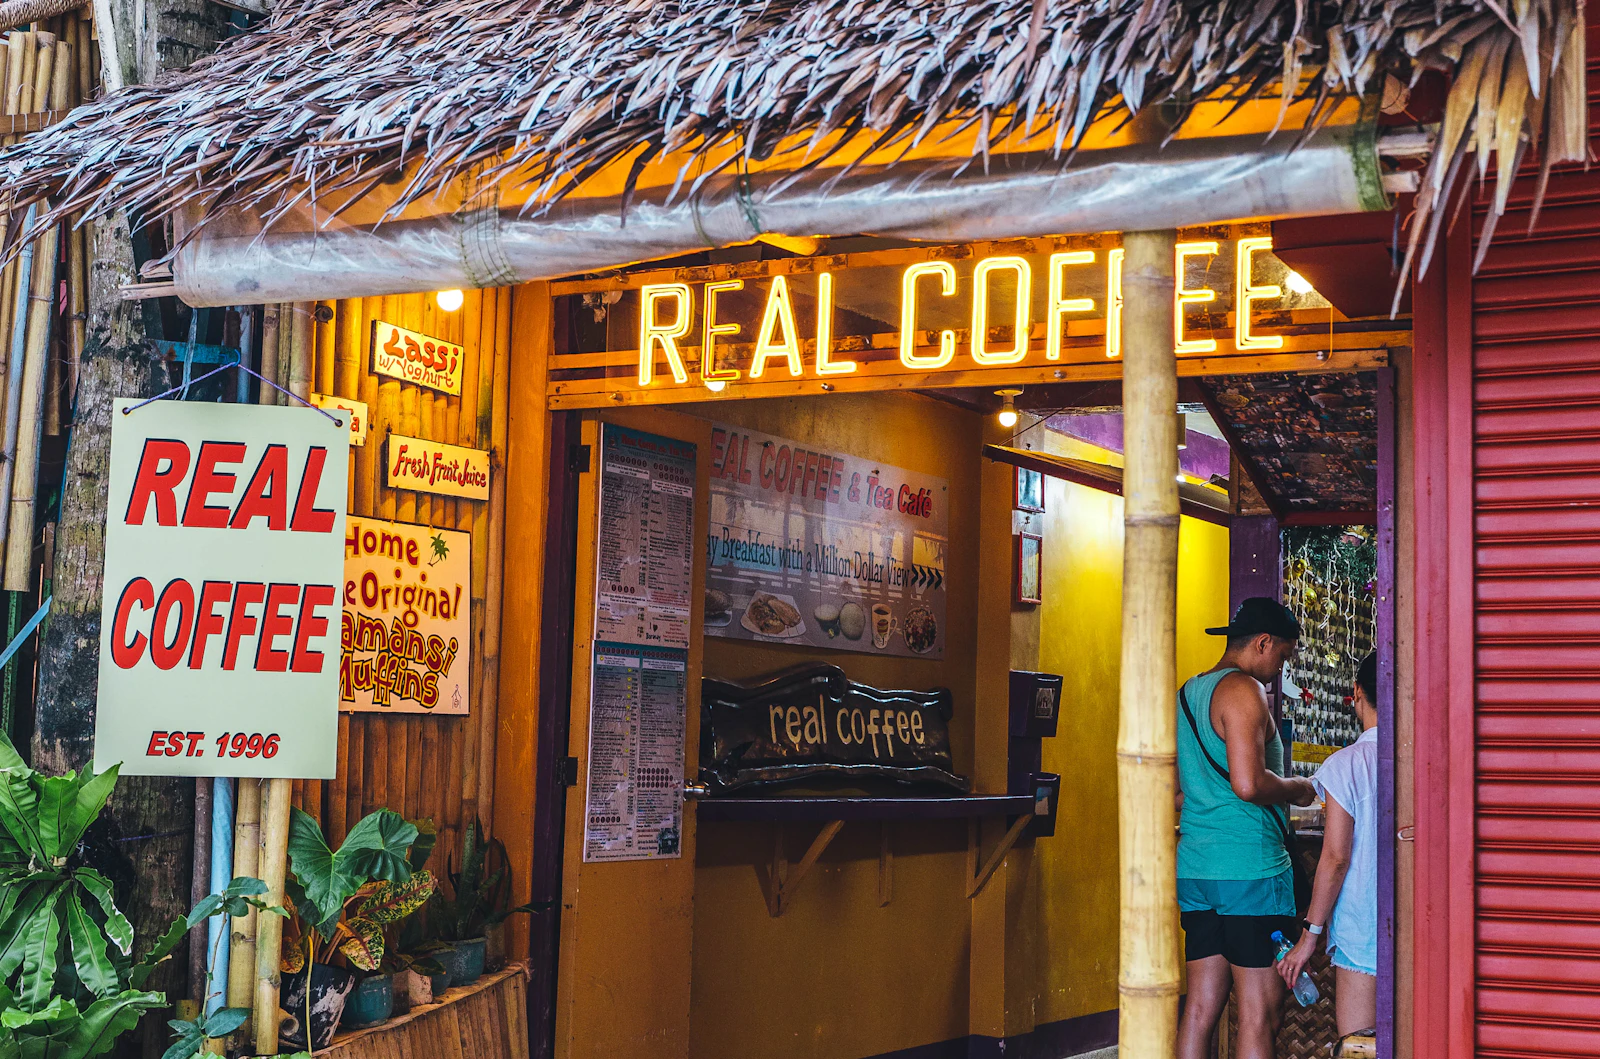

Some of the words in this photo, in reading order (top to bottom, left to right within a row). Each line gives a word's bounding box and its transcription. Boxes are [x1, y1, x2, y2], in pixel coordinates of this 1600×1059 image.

[384, 328, 459, 374] Lassi
[638, 272, 857, 386] REAL
[124, 437, 337, 533] REAL
[393, 444, 429, 479] Fresh
[429, 452, 460, 485] Fruit
[458, 458, 487, 488] Juice
[709, 427, 752, 486] EAL
[759, 441, 844, 504] COFFEE
[848, 472, 861, 502] &
[867, 475, 894, 510] Tea
[897, 483, 933, 519] Café
[344, 523, 420, 568] Home
[706, 535, 719, 566] ay
[721, 526, 776, 567] Breakfast
[778, 538, 804, 569] with
[806, 553, 812, 572] a
[815, 544, 851, 579] Million
[853, 552, 885, 583] Dollar
[886, 557, 910, 588] View
[110, 577, 337, 673] COFFEE
[360, 566, 463, 629] Original
[341, 610, 458, 678] amansi
[339, 651, 439, 708] Muffins
[146, 731, 205, 757] EST.
[215, 732, 281, 759] 1996
[769, 694, 827, 745] real
[836, 708, 925, 758] coffee
